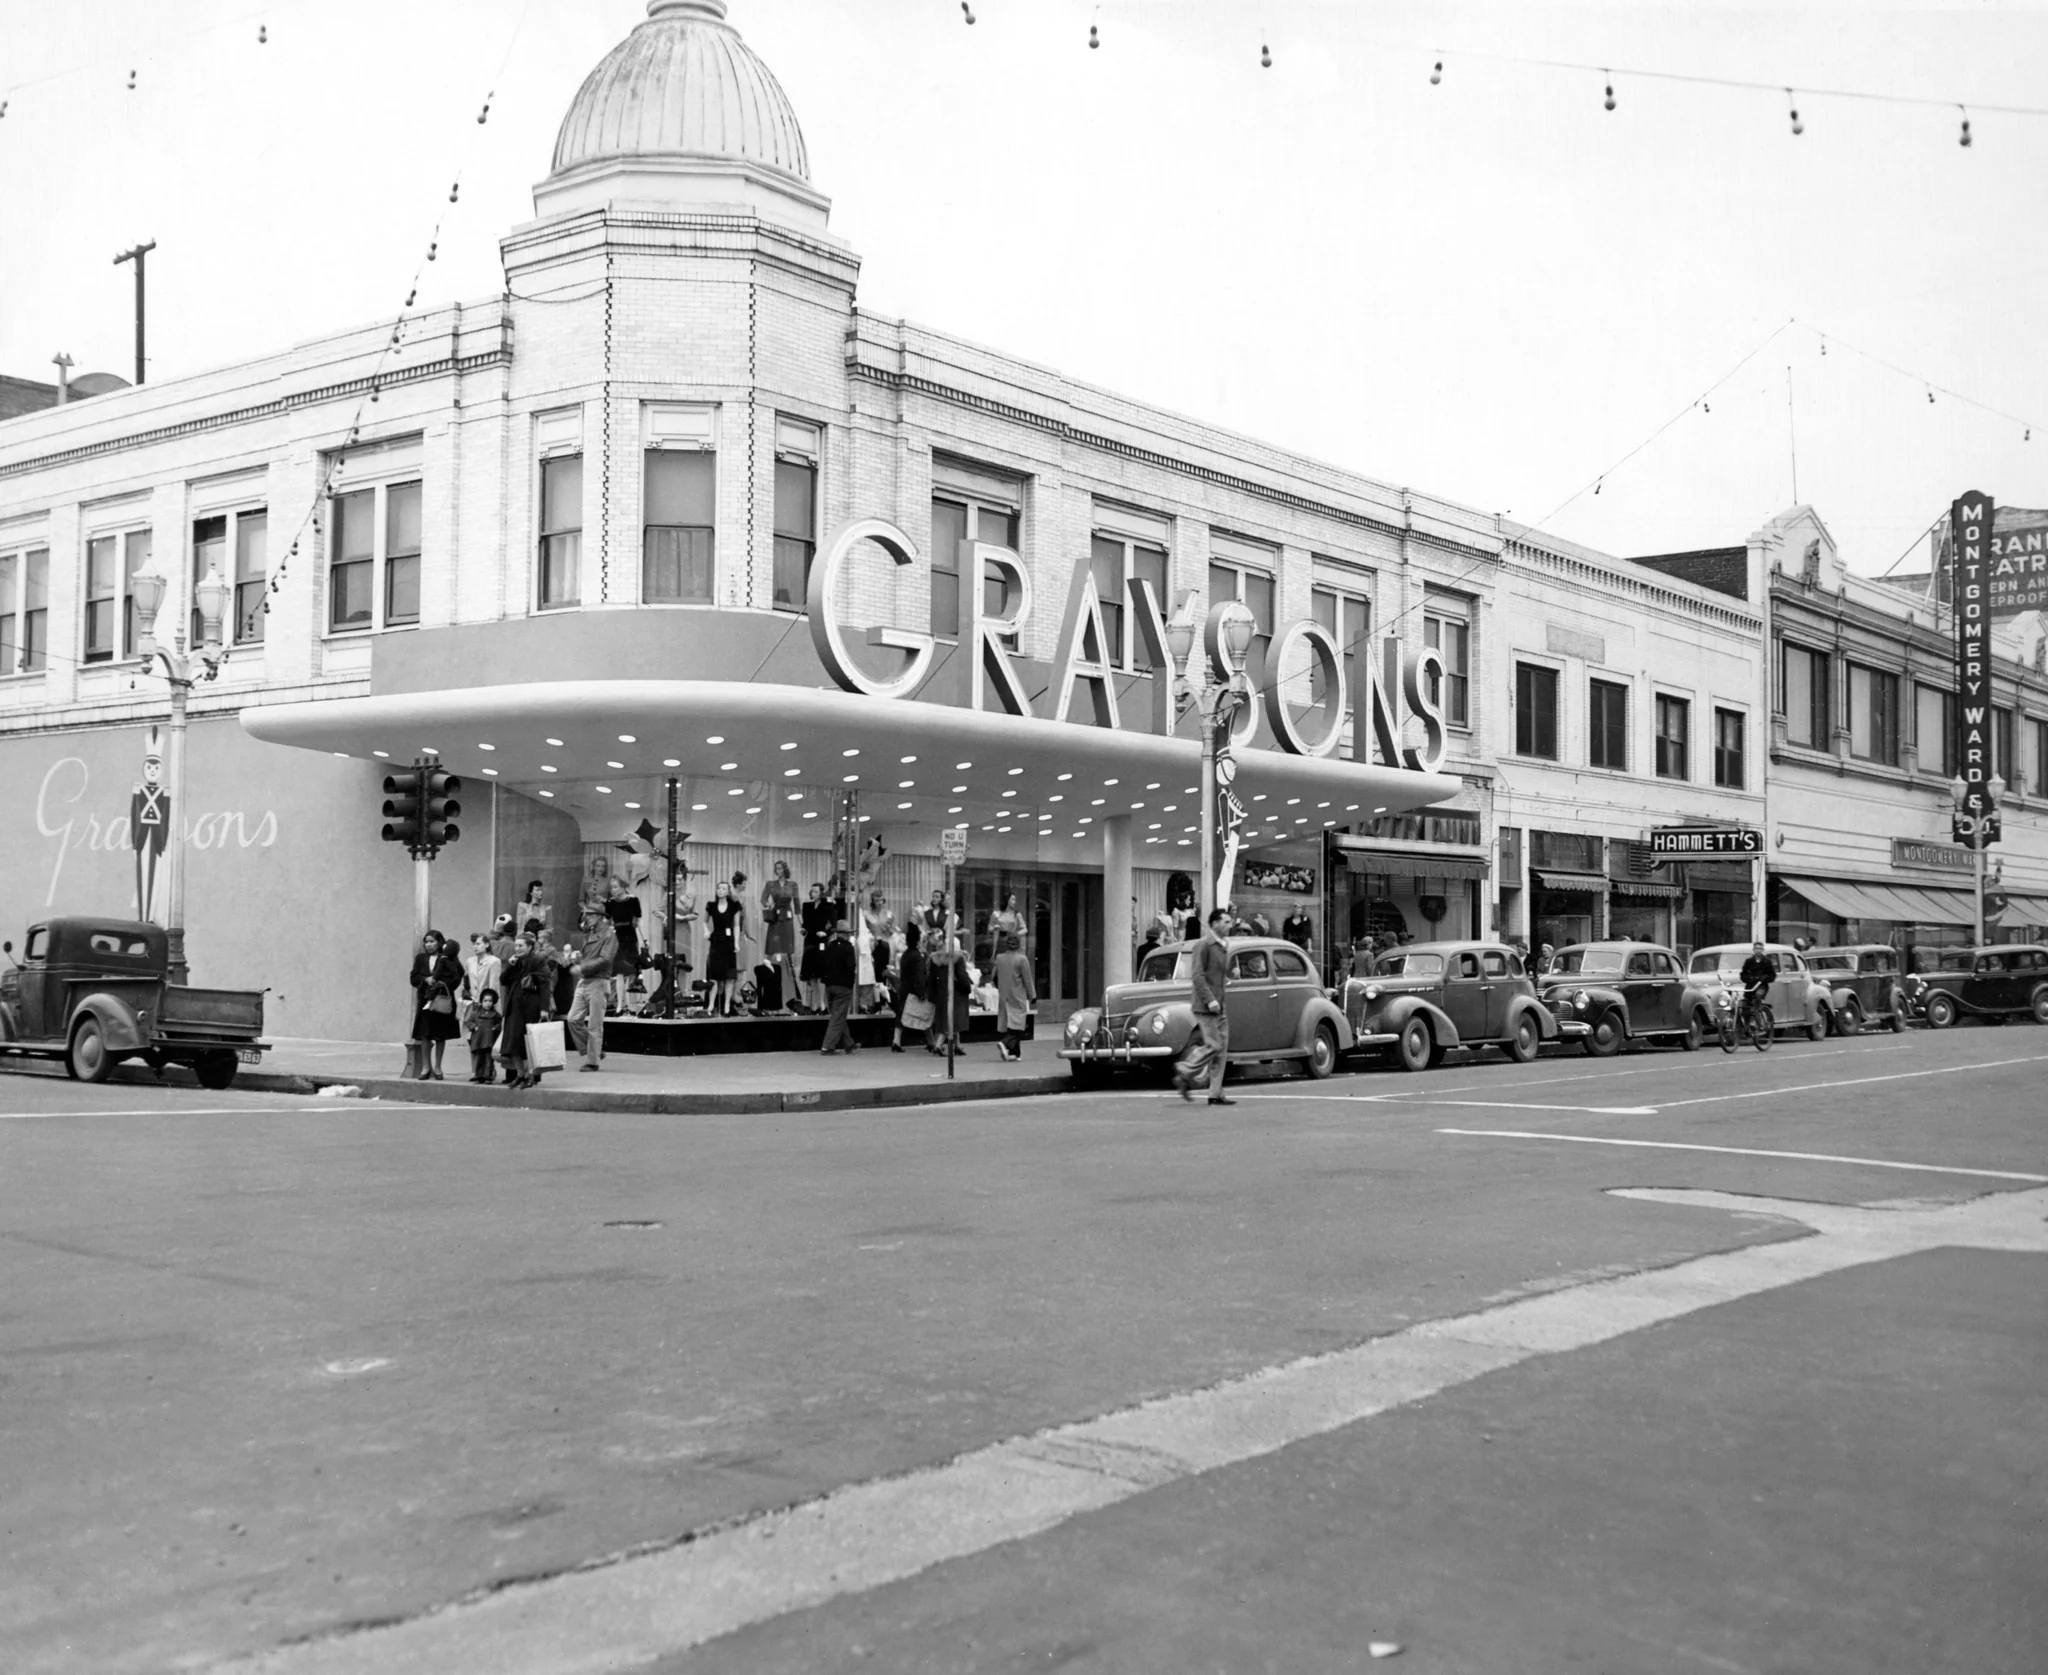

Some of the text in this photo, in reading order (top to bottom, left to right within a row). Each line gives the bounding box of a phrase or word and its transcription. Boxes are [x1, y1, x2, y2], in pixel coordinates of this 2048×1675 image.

[1990, 531, 2048, 555] RAN
[1989, 576, 2048, 594] ERN AN
[1962, 503, 1983, 696] MONTGOMERY
[1989, 590, 2047, 608] EPROOF
[808, 517, 1448, 773] GRAYSONS
[1964, 706, 1985, 783] WARD
[1968, 794, 1983, 809] &
[36, 756, 278, 909] Graons
[944, 832, 964, 840] NO U
[1654, 831, 1755, 851] HAMMETT'S
[944, 841, 964, 849] TURN
[1903, 845, 1977, 866] MONTGOMERY WAR
